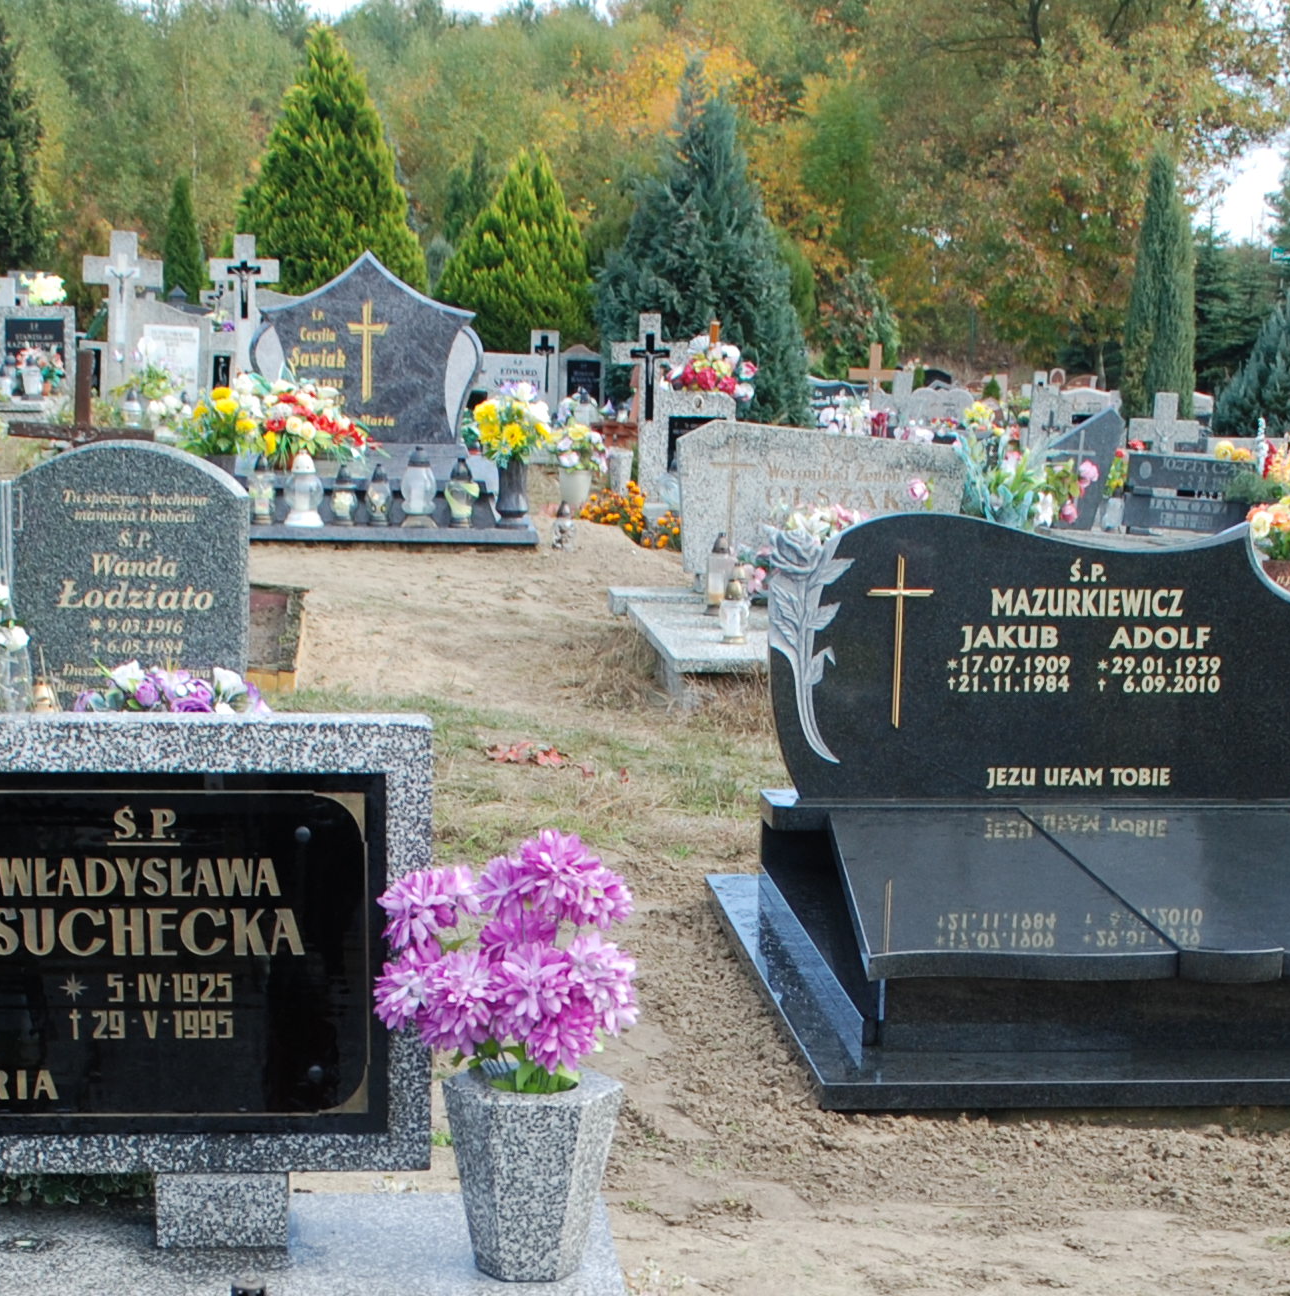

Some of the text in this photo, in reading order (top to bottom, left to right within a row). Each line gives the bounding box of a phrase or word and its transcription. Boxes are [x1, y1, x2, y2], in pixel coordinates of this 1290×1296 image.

[292, 346, 347, 369] Sawiak
[91, 552, 180, 578] Wanda
[1070, 558, 1108, 583] Ś.P.
[56, 578, 215, 612] Łodziato
[990, 588, 1185, 617] MAZURKIEWICZ
[106, 617, 185, 636] 9.03.1916
[960, 625, 1212, 653] JAKUB ADOLF
[960, 656, 1222, 676] 17.07.1909 29.01.1939
[957, 674, 1222, 694] 21.11.1984 6.09.2010
[985, 767, 1172, 789] JEZU UFAM TOBIE
